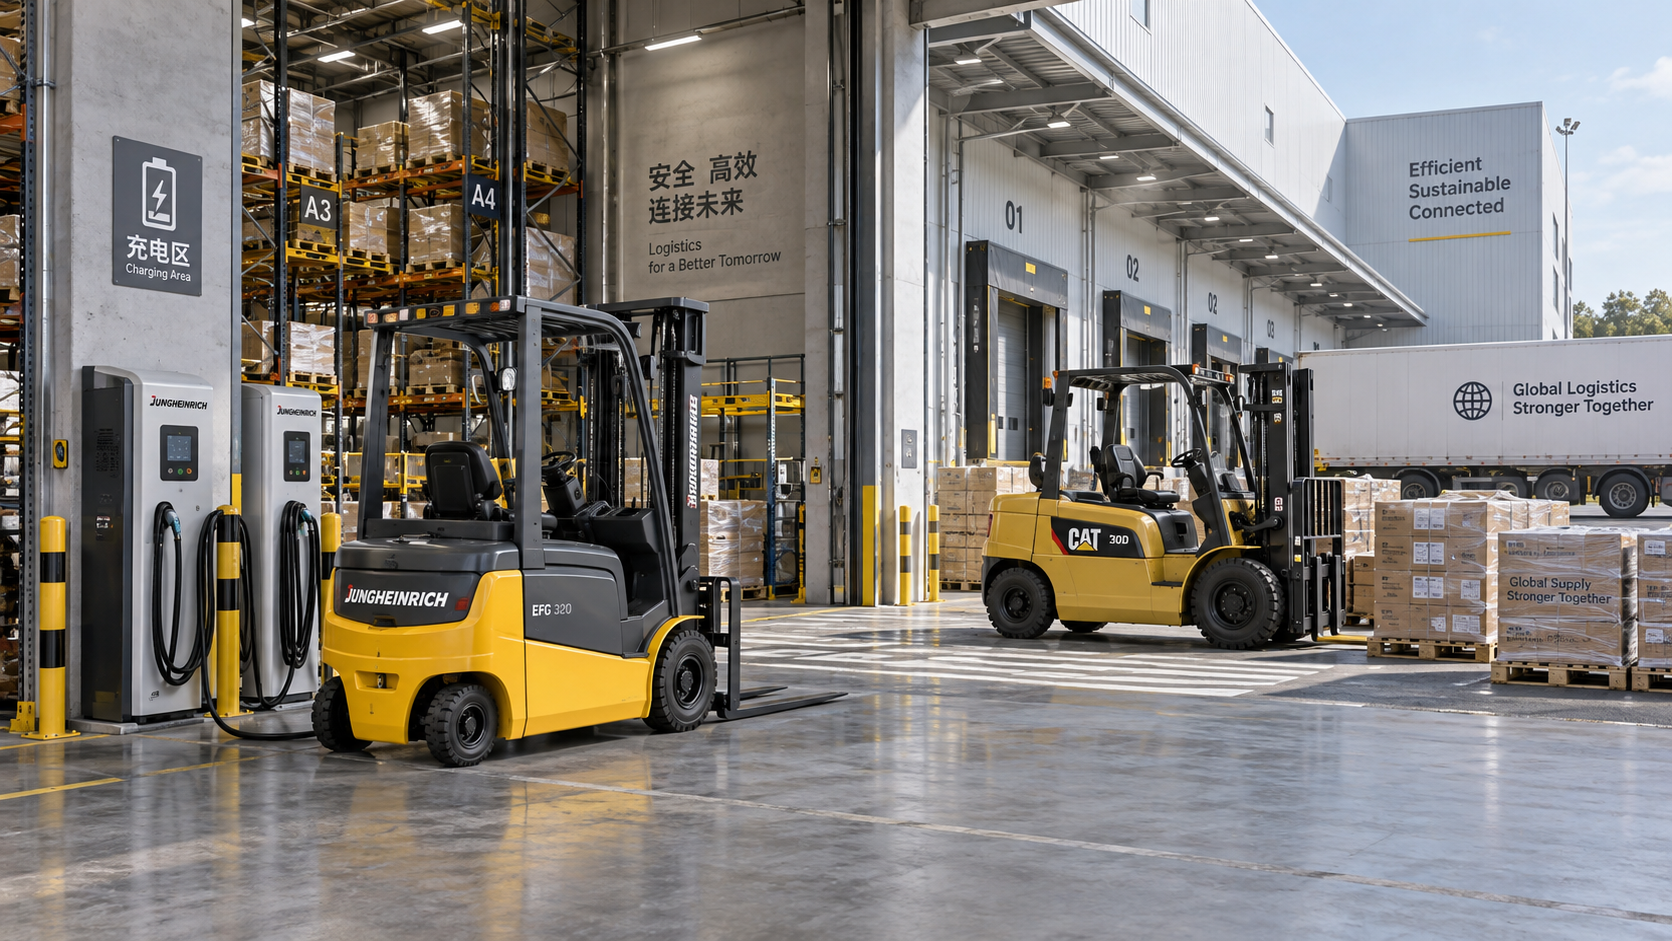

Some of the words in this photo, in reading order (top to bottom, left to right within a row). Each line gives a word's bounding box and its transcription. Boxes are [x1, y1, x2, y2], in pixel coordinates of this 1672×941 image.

[648, 159, 695, 192] 安全
[709, 150, 758, 185] 高效
[1409, 156, 1483, 178] Efficient
[471, 183, 496, 211] A4
[1409, 175, 1511, 199] Sustainable
[304, 195, 332, 223] A3
[648, 187, 744, 225] 连接未来
[1005, 200, 1023, 234] 01
[1409, 197, 1504, 220] Connected
[126, 234, 190, 268] 充电区
[649, 239, 702, 257] Logistics
[125, 262, 168, 282] Charging
[170, 269, 191, 283] Area
[649, 260, 665, 274] for
[668, 262, 676, 272] a
[678, 257, 716, 272] Better
[718, 251, 782, 268] Tomorrow
[1126, 254, 1139, 283] 02
[1207, 292, 1218, 315] 02
[1266, 319, 1275, 339] 03
[1513, 381, 1562, 397] Global
[1567, 380, 1637, 398] Logistics
[150, 395, 208, 410] JUNGHEINRICH
[1513, 399, 1580, 417] Stronger
[1583, 397, 1654, 415] Together
[1068, 527, 1102, 551] CAT
[1109, 534, 1129, 545] 30D
[1509, 576, 1548, 589] Global
[1550, 577, 1592, 591] Supply
[345, 584, 449, 607] JUNGHEINRICH
[1507, 590, 1556, 604] Stronger
[1558, 591, 1613, 606] Together
[532, 603, 552, 617] EFG
[553, 603, 572, 615] 320
